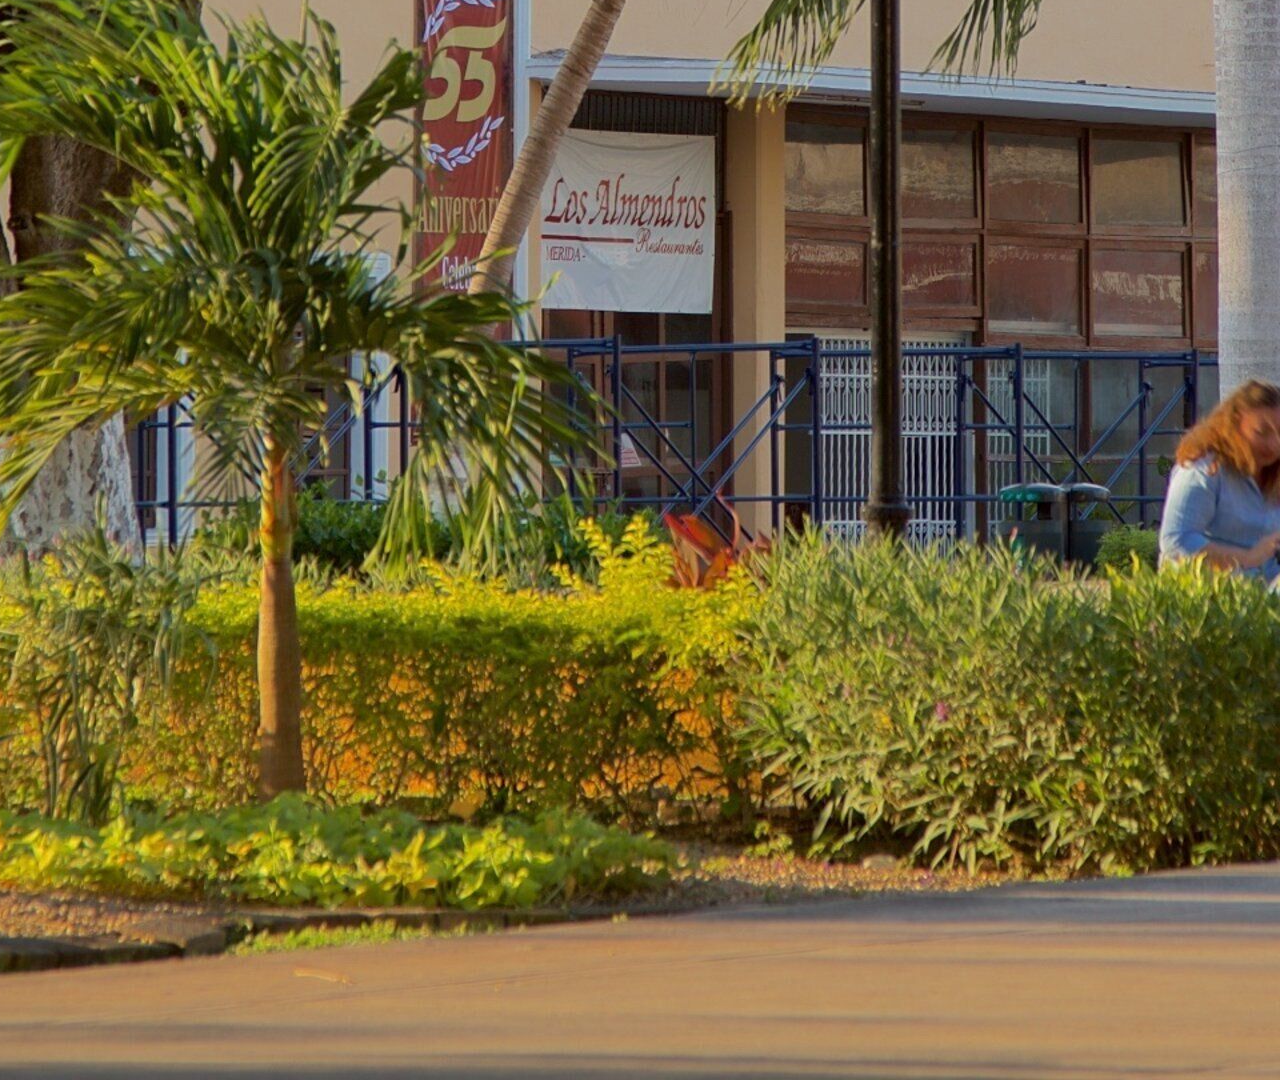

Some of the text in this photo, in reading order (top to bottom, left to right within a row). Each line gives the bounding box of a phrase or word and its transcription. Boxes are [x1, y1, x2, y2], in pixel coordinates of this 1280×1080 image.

[422, 16, 507, 122] 55
[417, 184, 501, 234] Aniversari
[544, 173, 706, 229] Los Almendros
[635, 227, 705, 256] Restaurantes
